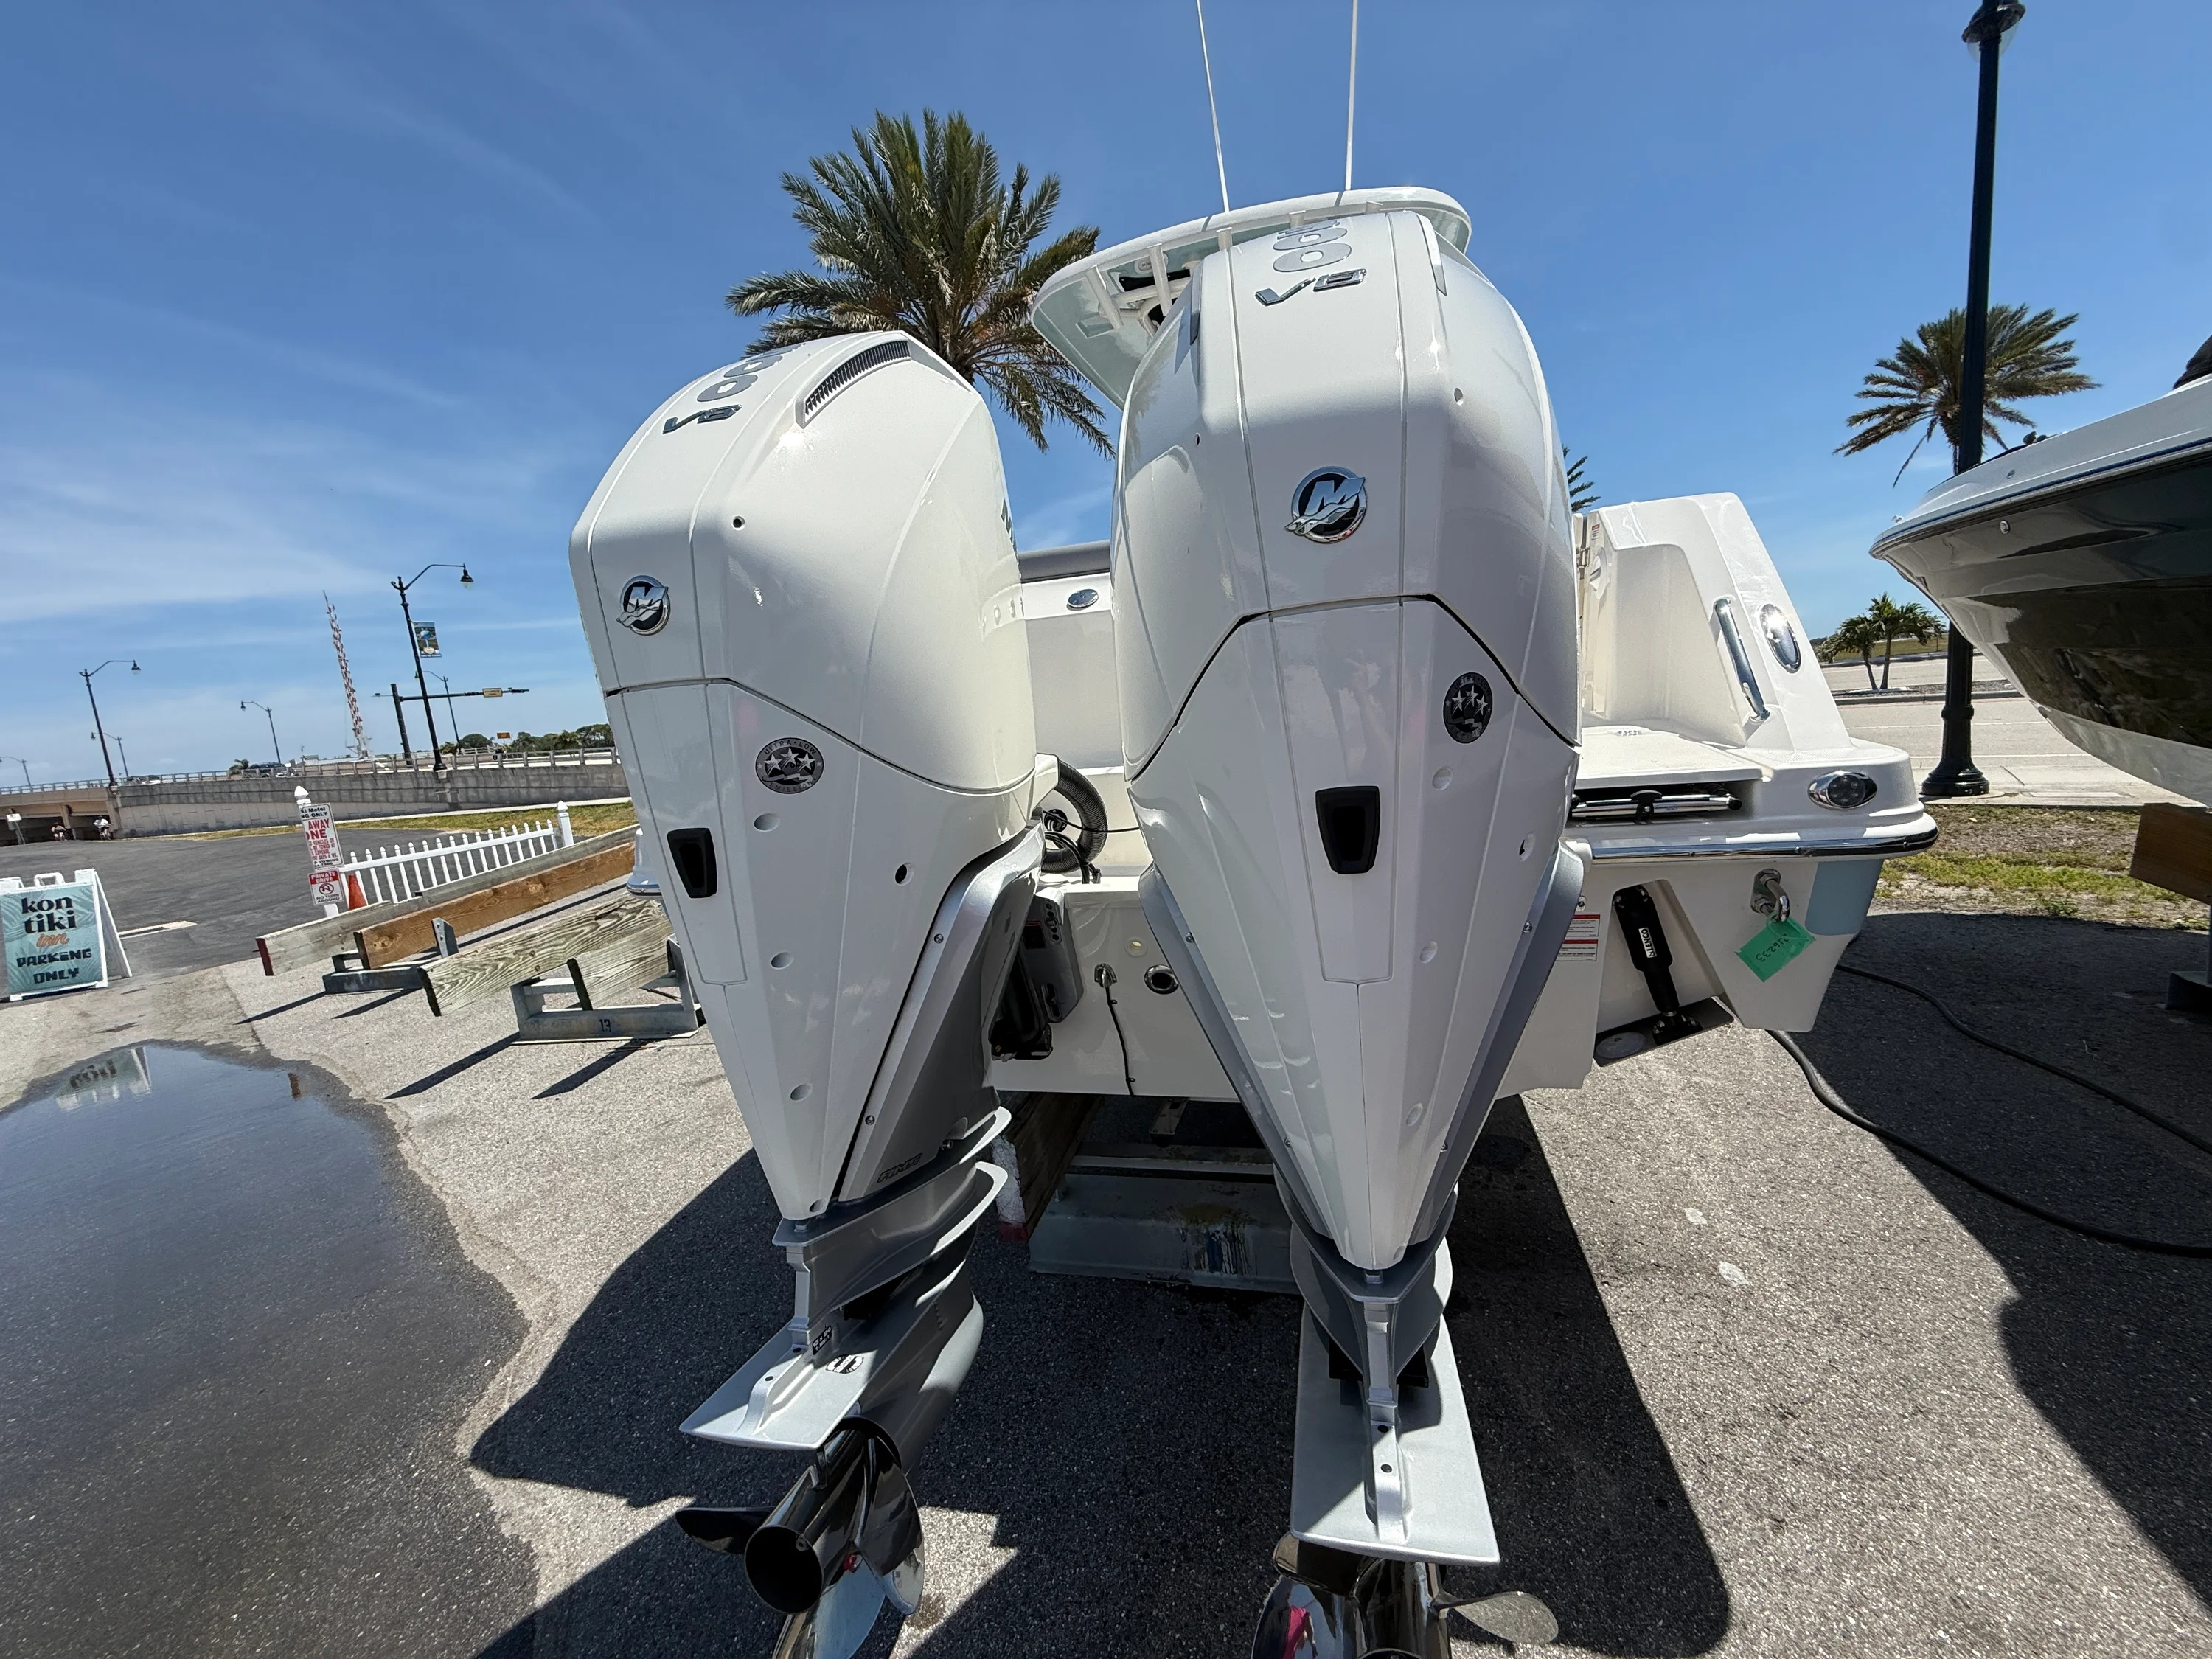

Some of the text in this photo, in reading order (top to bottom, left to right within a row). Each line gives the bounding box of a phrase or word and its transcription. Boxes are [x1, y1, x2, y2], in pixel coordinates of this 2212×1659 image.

[764, 740, 817, 755] ULTRA LOW
[308, 818, 330, 830] AWAY
[310, 872, 336, 880] PRIVATE
[21, 897, 74, 914] kon
[24, 910, 77, 934] tiki
[36, 932, 70, 947] inn
[16, 948, 93, 968] PARKING
[32, 967, 80, 984] ONLY
